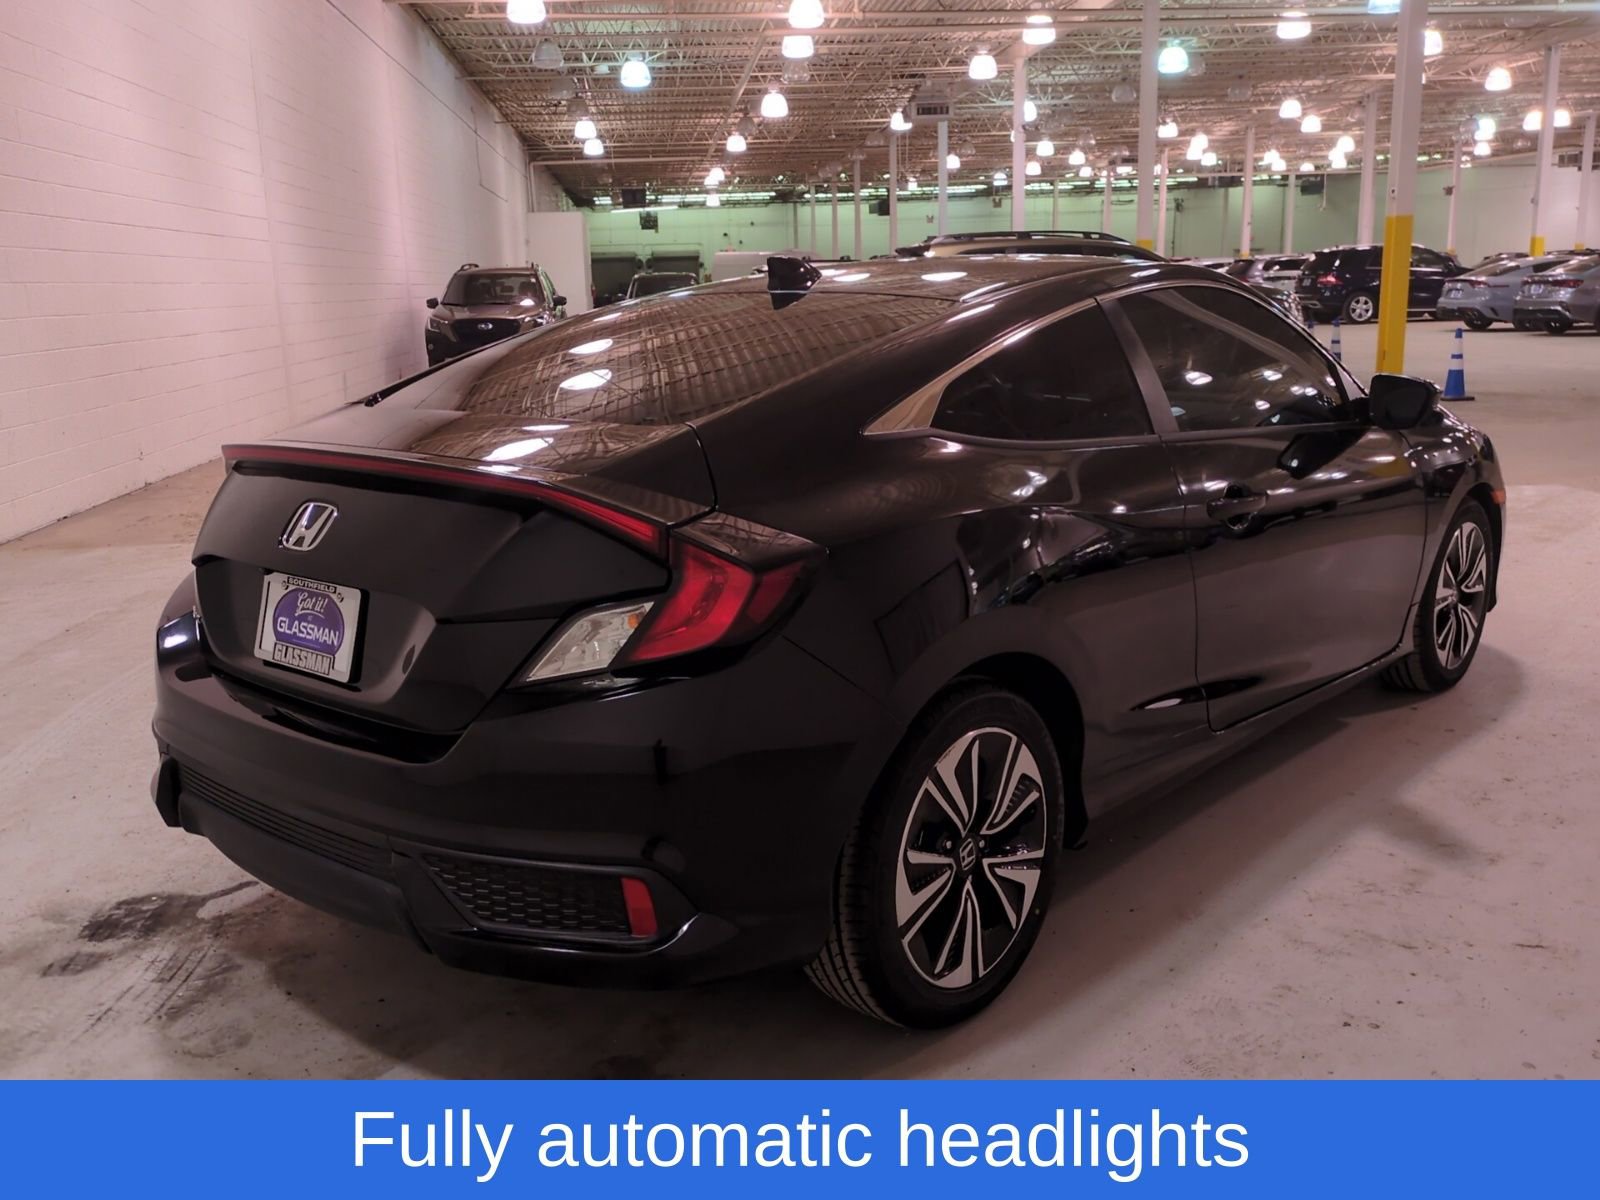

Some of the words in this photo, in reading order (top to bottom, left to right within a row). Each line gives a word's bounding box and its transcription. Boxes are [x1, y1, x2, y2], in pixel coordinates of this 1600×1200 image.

[288, 577, 336, 593] SOUTHFIELD
[297, 592, 316, 614] Got
[277, 617, 339, 646] GLASSMAN
[273, 643, 331, 676] GLASSMAN
